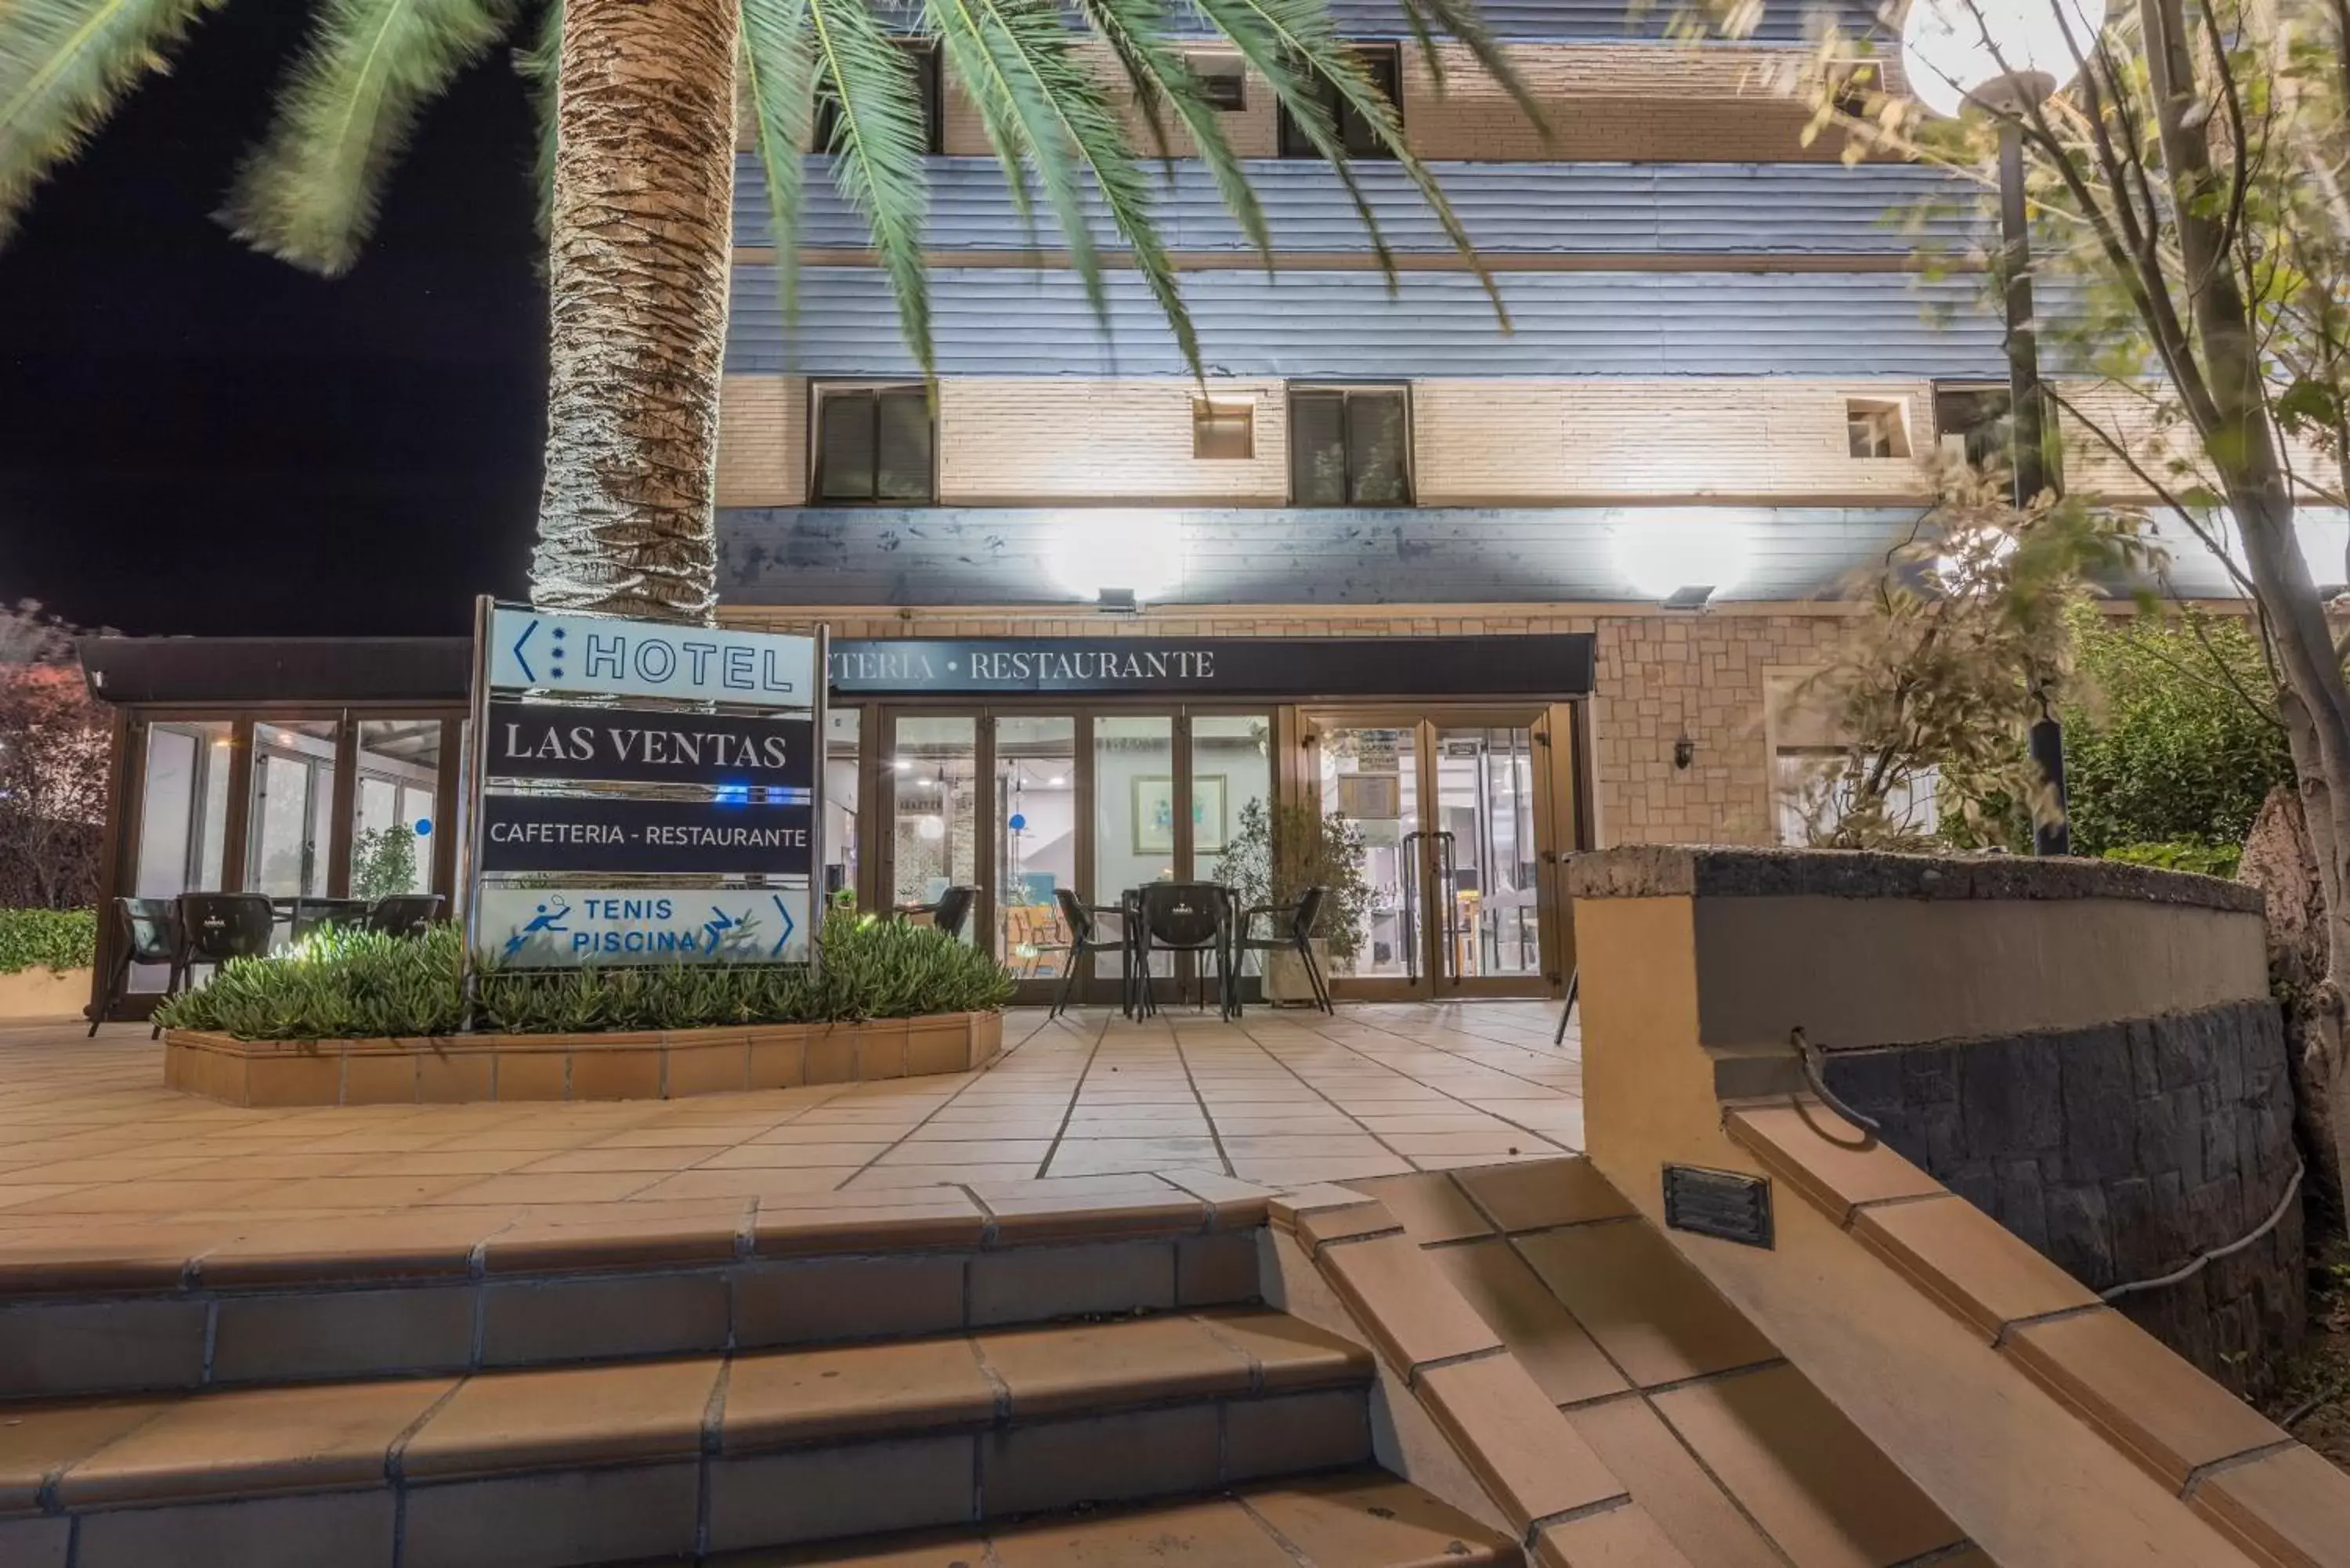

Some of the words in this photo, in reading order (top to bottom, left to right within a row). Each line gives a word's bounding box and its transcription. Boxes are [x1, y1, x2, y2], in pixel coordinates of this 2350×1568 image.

[586, 634, 793, 692] HOTEL
[970, 652, 1214, 679] RESTAURANTE
[505, 723, 595, 761] LAS
[608, 728, 786, 768] VENTAS
[490, 823, 624, 844] CAFETERIA
[646, 826, 807, 847] RESTAURANTE
[584, 899, 672, 919] TENIS
[573, 930, 696, 952] PISCINA
